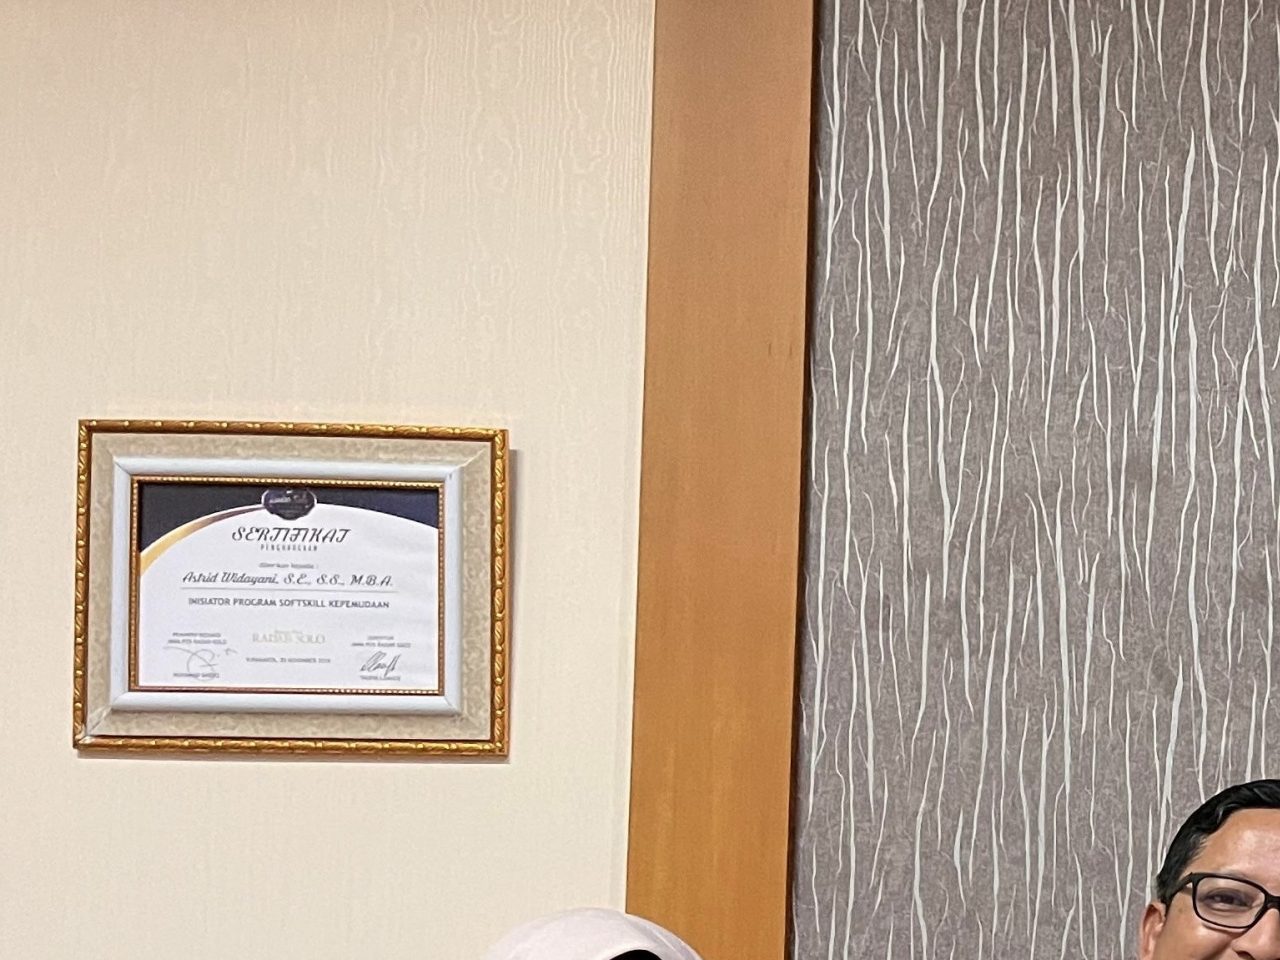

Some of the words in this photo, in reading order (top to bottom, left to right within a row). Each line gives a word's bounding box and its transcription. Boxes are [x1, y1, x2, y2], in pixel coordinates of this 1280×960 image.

[231, 526, 352, 543] SERTIFIKAT
[182, 571, 218, 584] Astrid
[233, 597, 277, 606] PROGRAM
[279, 598, 326, 607] SOFTSKILL
[328, 599, 390, 608] KEPEMUDAAN
